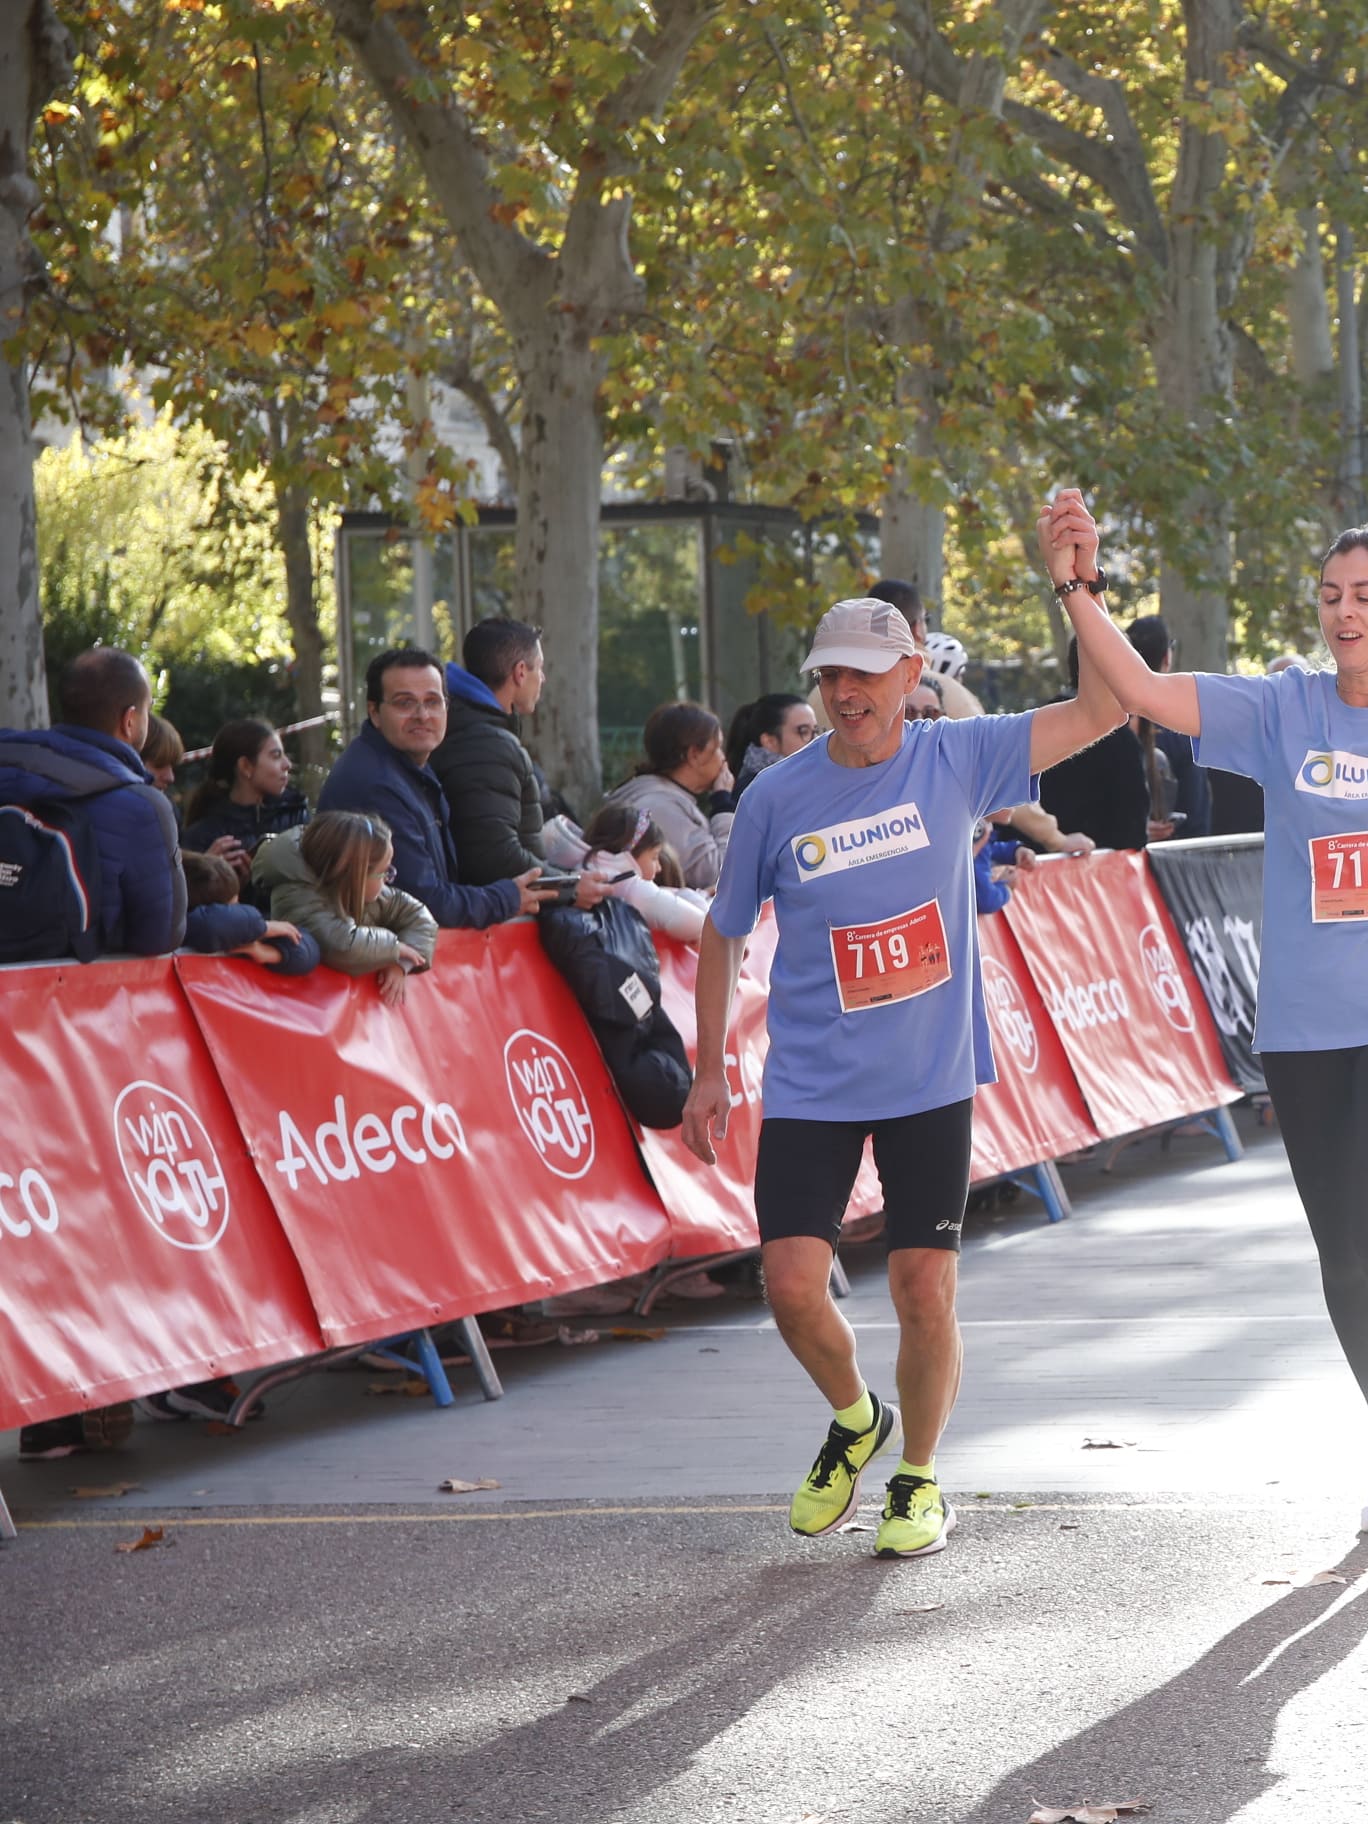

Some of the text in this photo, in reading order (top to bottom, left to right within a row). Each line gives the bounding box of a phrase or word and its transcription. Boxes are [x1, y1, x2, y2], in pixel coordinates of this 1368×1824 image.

[831, 813, 921, 854] ILUNION
[847, 934, 910, 979] 719
[1050, 971, 1130, 1032] Adecco
[275, 1094, 470, 1191] Adecco
